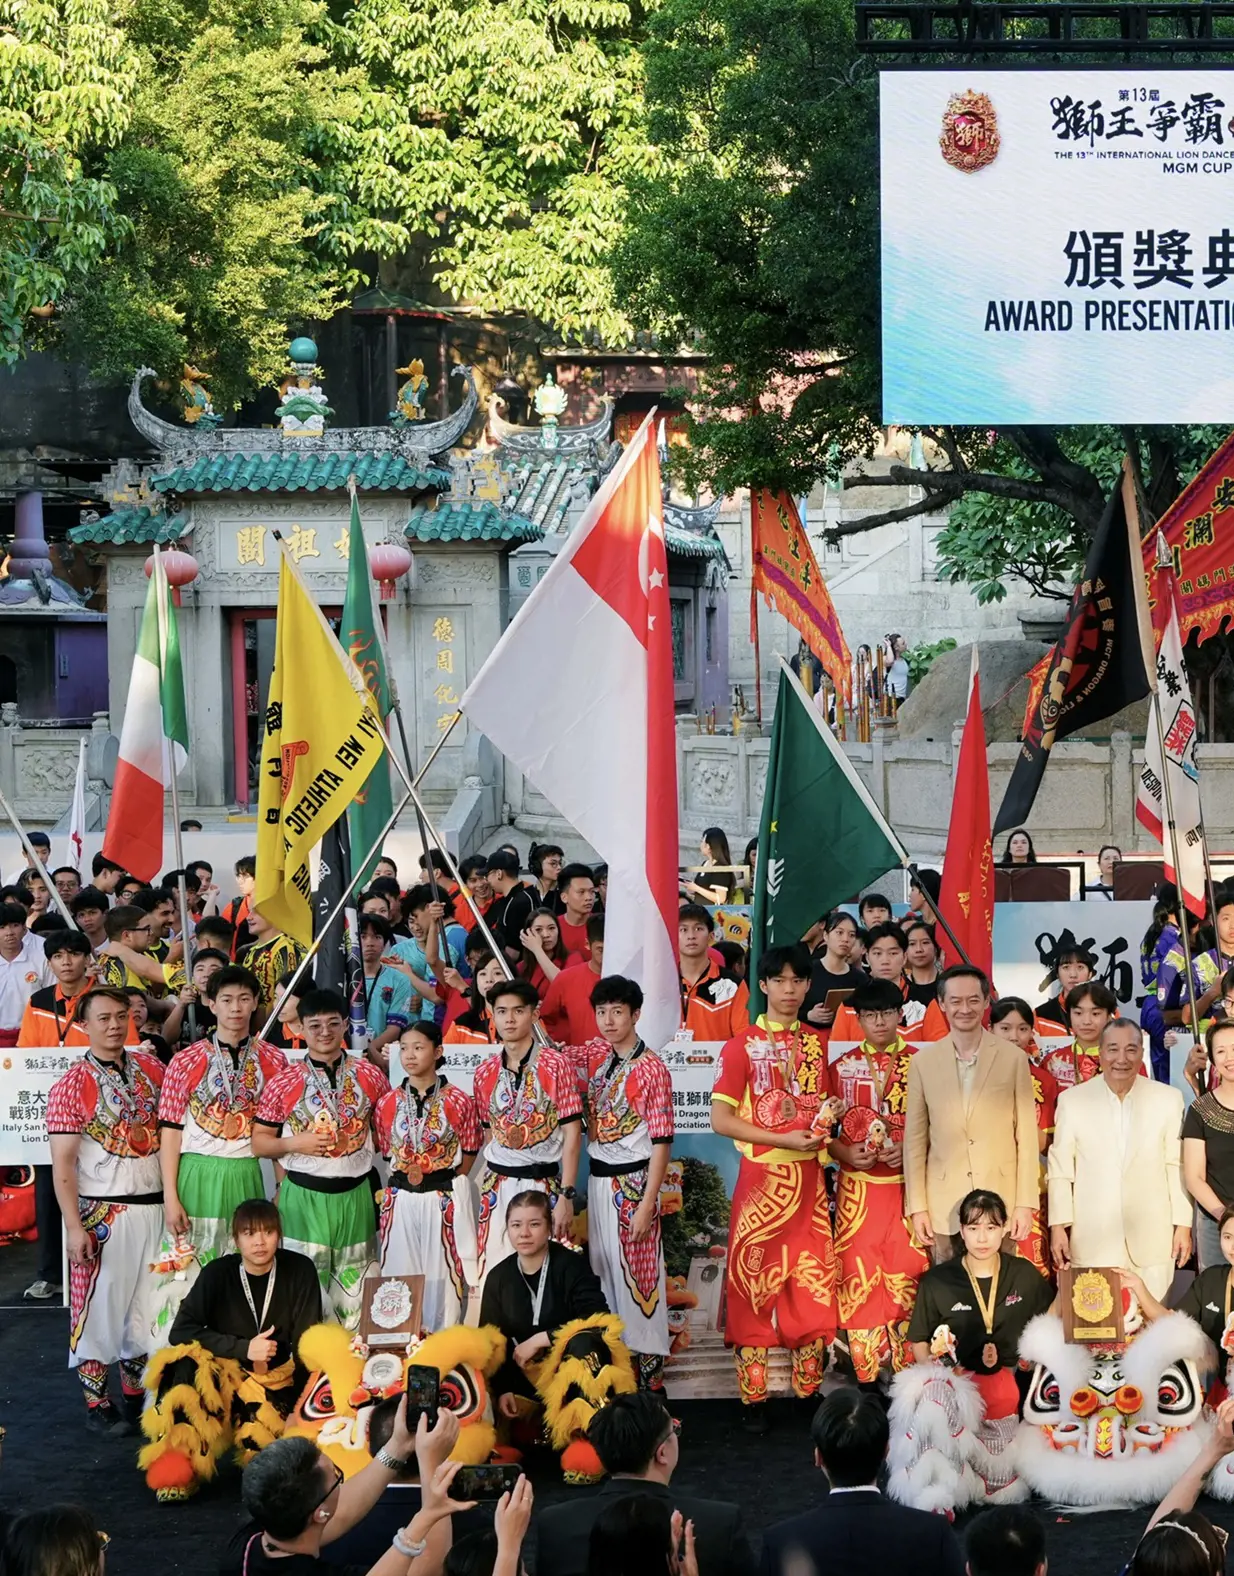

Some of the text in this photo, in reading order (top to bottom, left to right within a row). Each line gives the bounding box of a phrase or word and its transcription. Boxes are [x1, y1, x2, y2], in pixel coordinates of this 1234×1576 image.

[1118, 88, 1160, 102] 第13屆
[1050, 93, 1225, 148] 獅王爭霸
[1054, 151, 1073, 160] THE
[1096, 151, 1173, 160] INTERNATIONAL
[1176, 151, 1199, 160] LION
[1202, 151, 1234, 159] DANCE
[1162, 162, 1233, 174] MGM CUP
[983, 299, 1073, 332] AWARD
[17, 1089, 50, 1105] 意大
[679, 1110, 710, 1119] Dragon
[2, 1123, 41, 1133] Italy San
[22, 1135, 41, 1143] Lion
